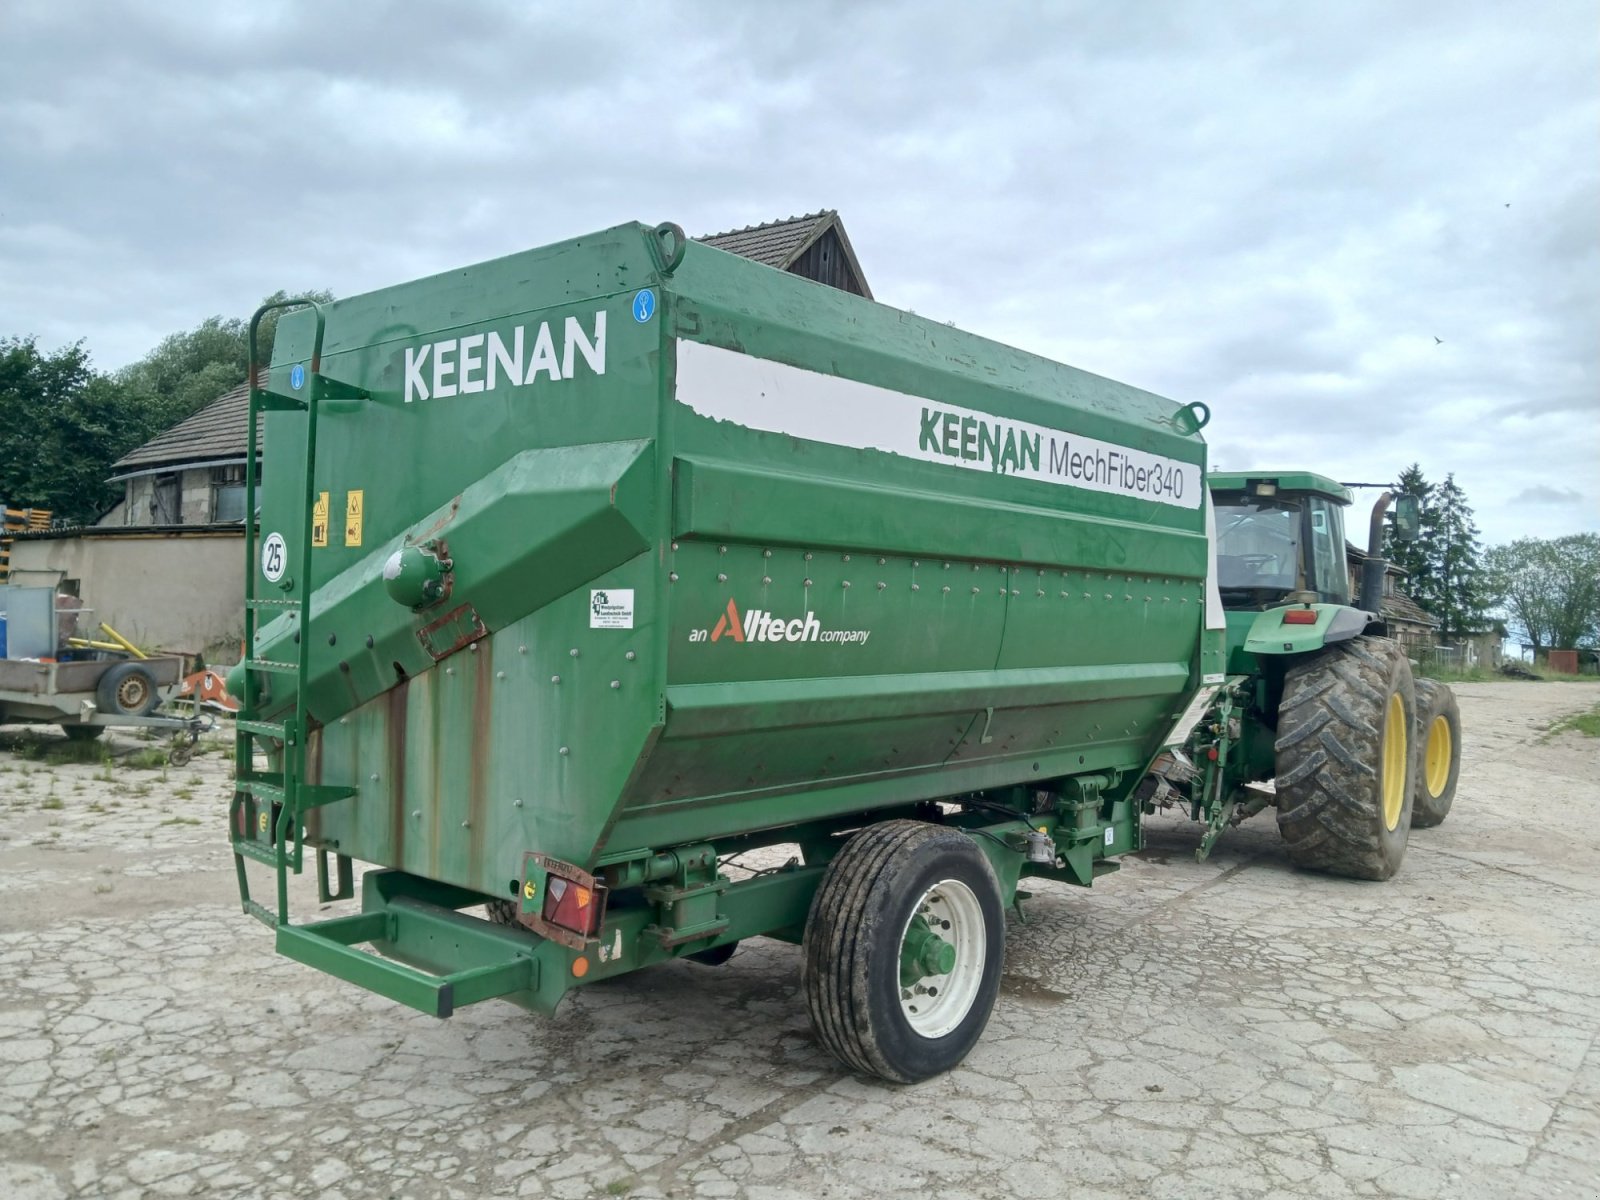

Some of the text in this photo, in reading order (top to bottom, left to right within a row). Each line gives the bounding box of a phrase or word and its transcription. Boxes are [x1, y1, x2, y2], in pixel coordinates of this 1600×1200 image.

[404, 310, 607, 403] KEENAN
[919, 407, 1184, 499] KEENAN MechFiber340
[267, 543, 282, 573] 25
[689, 597, 870, 646] an Alltech company
